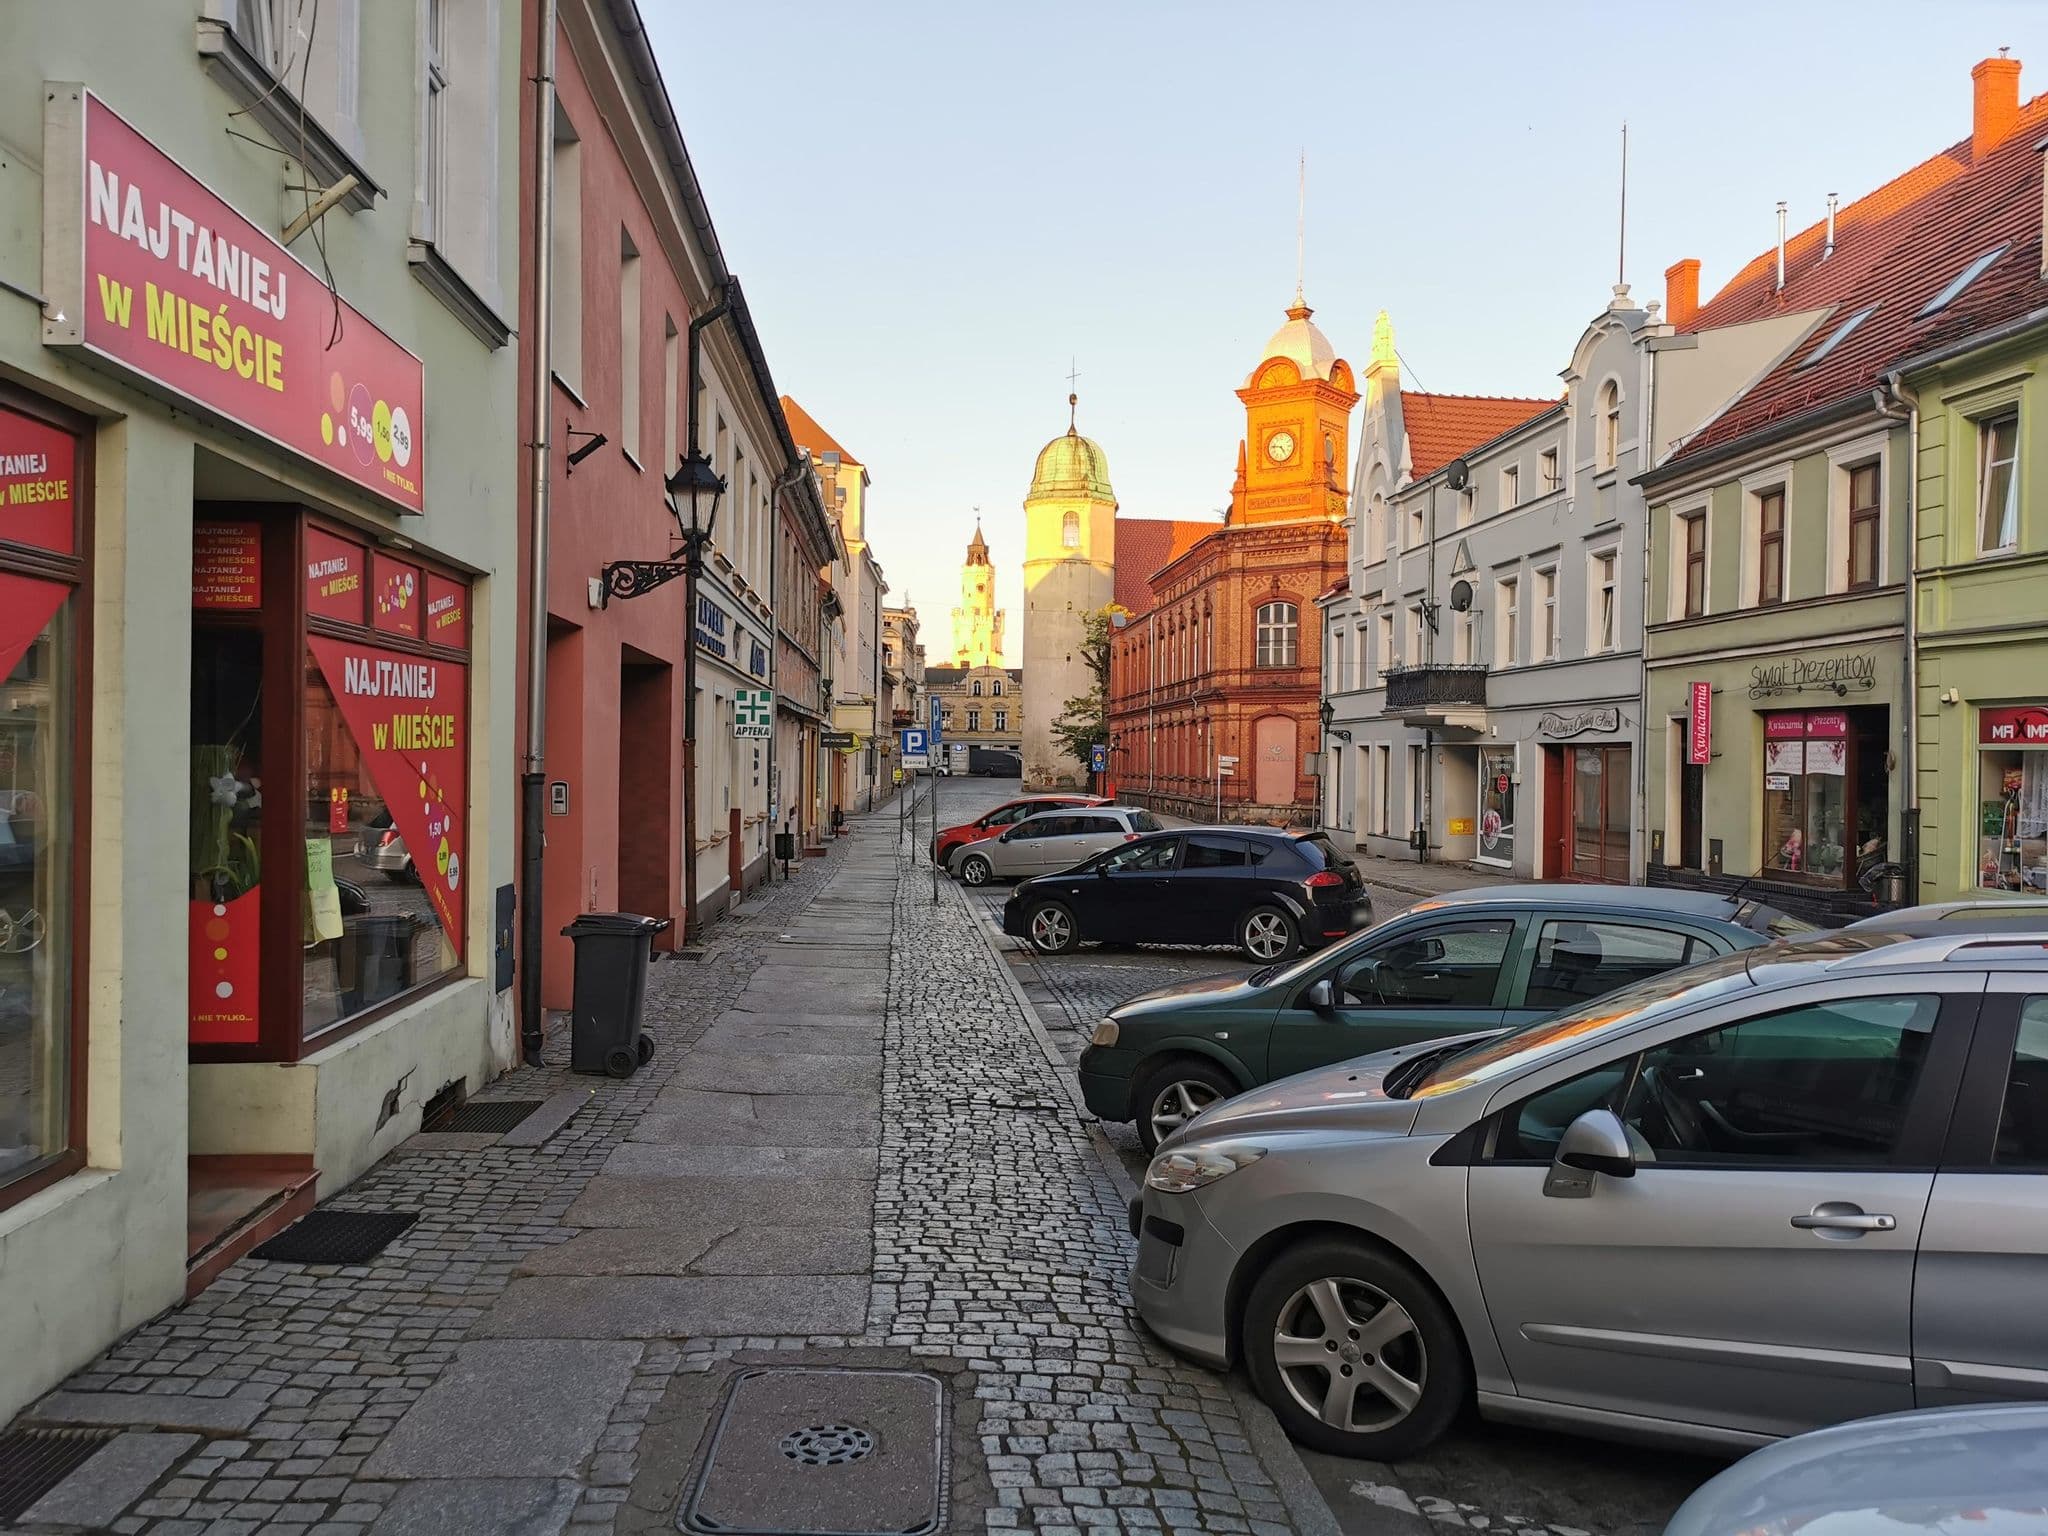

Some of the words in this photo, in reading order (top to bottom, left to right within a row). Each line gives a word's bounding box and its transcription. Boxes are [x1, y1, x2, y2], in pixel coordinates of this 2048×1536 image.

[89, 159, 288, 321] NAJTANIEJ
[97, 273, 133, 329] w
[144, 281, 284, 392] MIEŚCIE
[351, 406, 373, 444] 5,99
[9, 477, 69, 505] MIEŚCIE
[308, 557, 348, 579] NAJTANIEJ
[329, 574, 359, 595] MIEŚCIE
[344, 656, 436, 699] NAJTANIEJ
[372, 723, 388, 750] w
[393, 706, 455, 751] MIEŚCIE
[736, 726, 770, 737] APTEKA
[1694, 684, 1708, 760] Kwiaciarnia
[907, 732, 923, 753] P
[429, 822, 442, 838] 1,50
